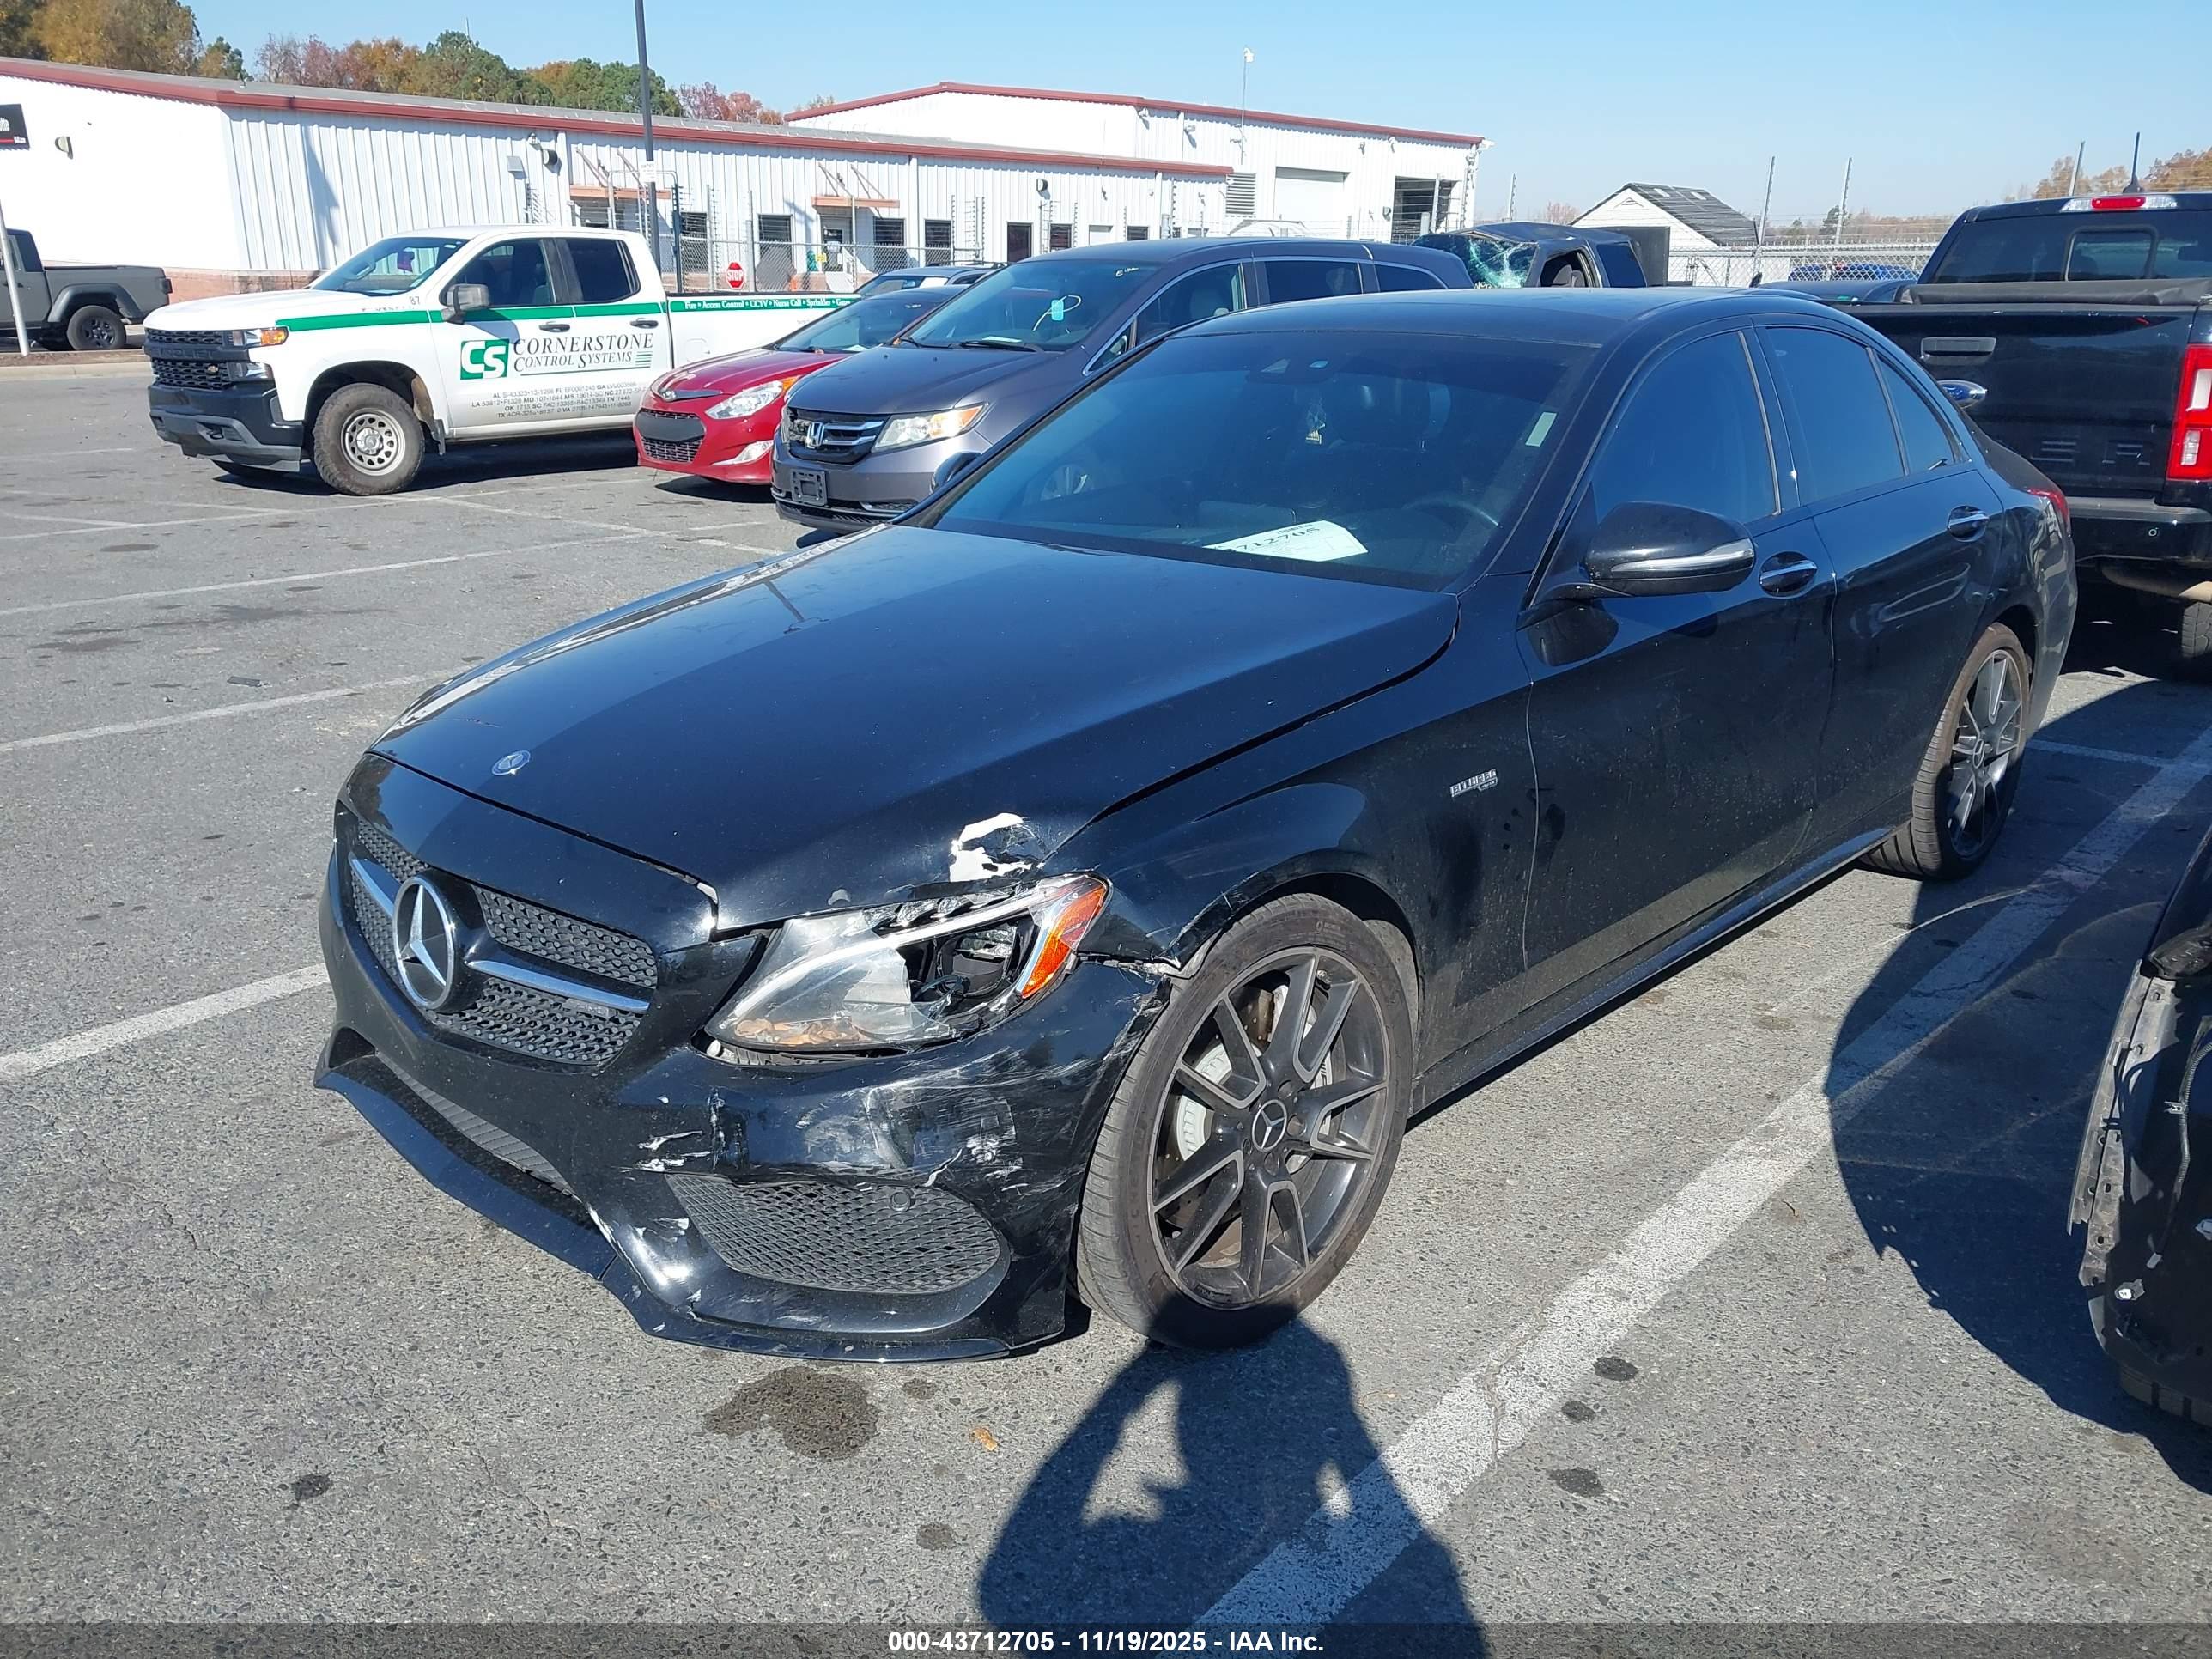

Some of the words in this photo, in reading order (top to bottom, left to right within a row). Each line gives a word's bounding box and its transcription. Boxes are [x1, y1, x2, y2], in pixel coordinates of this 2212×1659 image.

[726, 269, 744, 281] STOP
[684, 301, 697, 310] Fire
[702, 301, 721, 310] Access
[722, 300, 744, 309] Control
[750, 300, 769, 308] CCTV
[790, 299, 801, 307] Call
[514, 332, 653, 356] CORNERSTONE
[461, 339, 507, 379] CS
[514, 354, 574, 373] CONTROL
[577, 350, 633, 369] SYSTEMS
